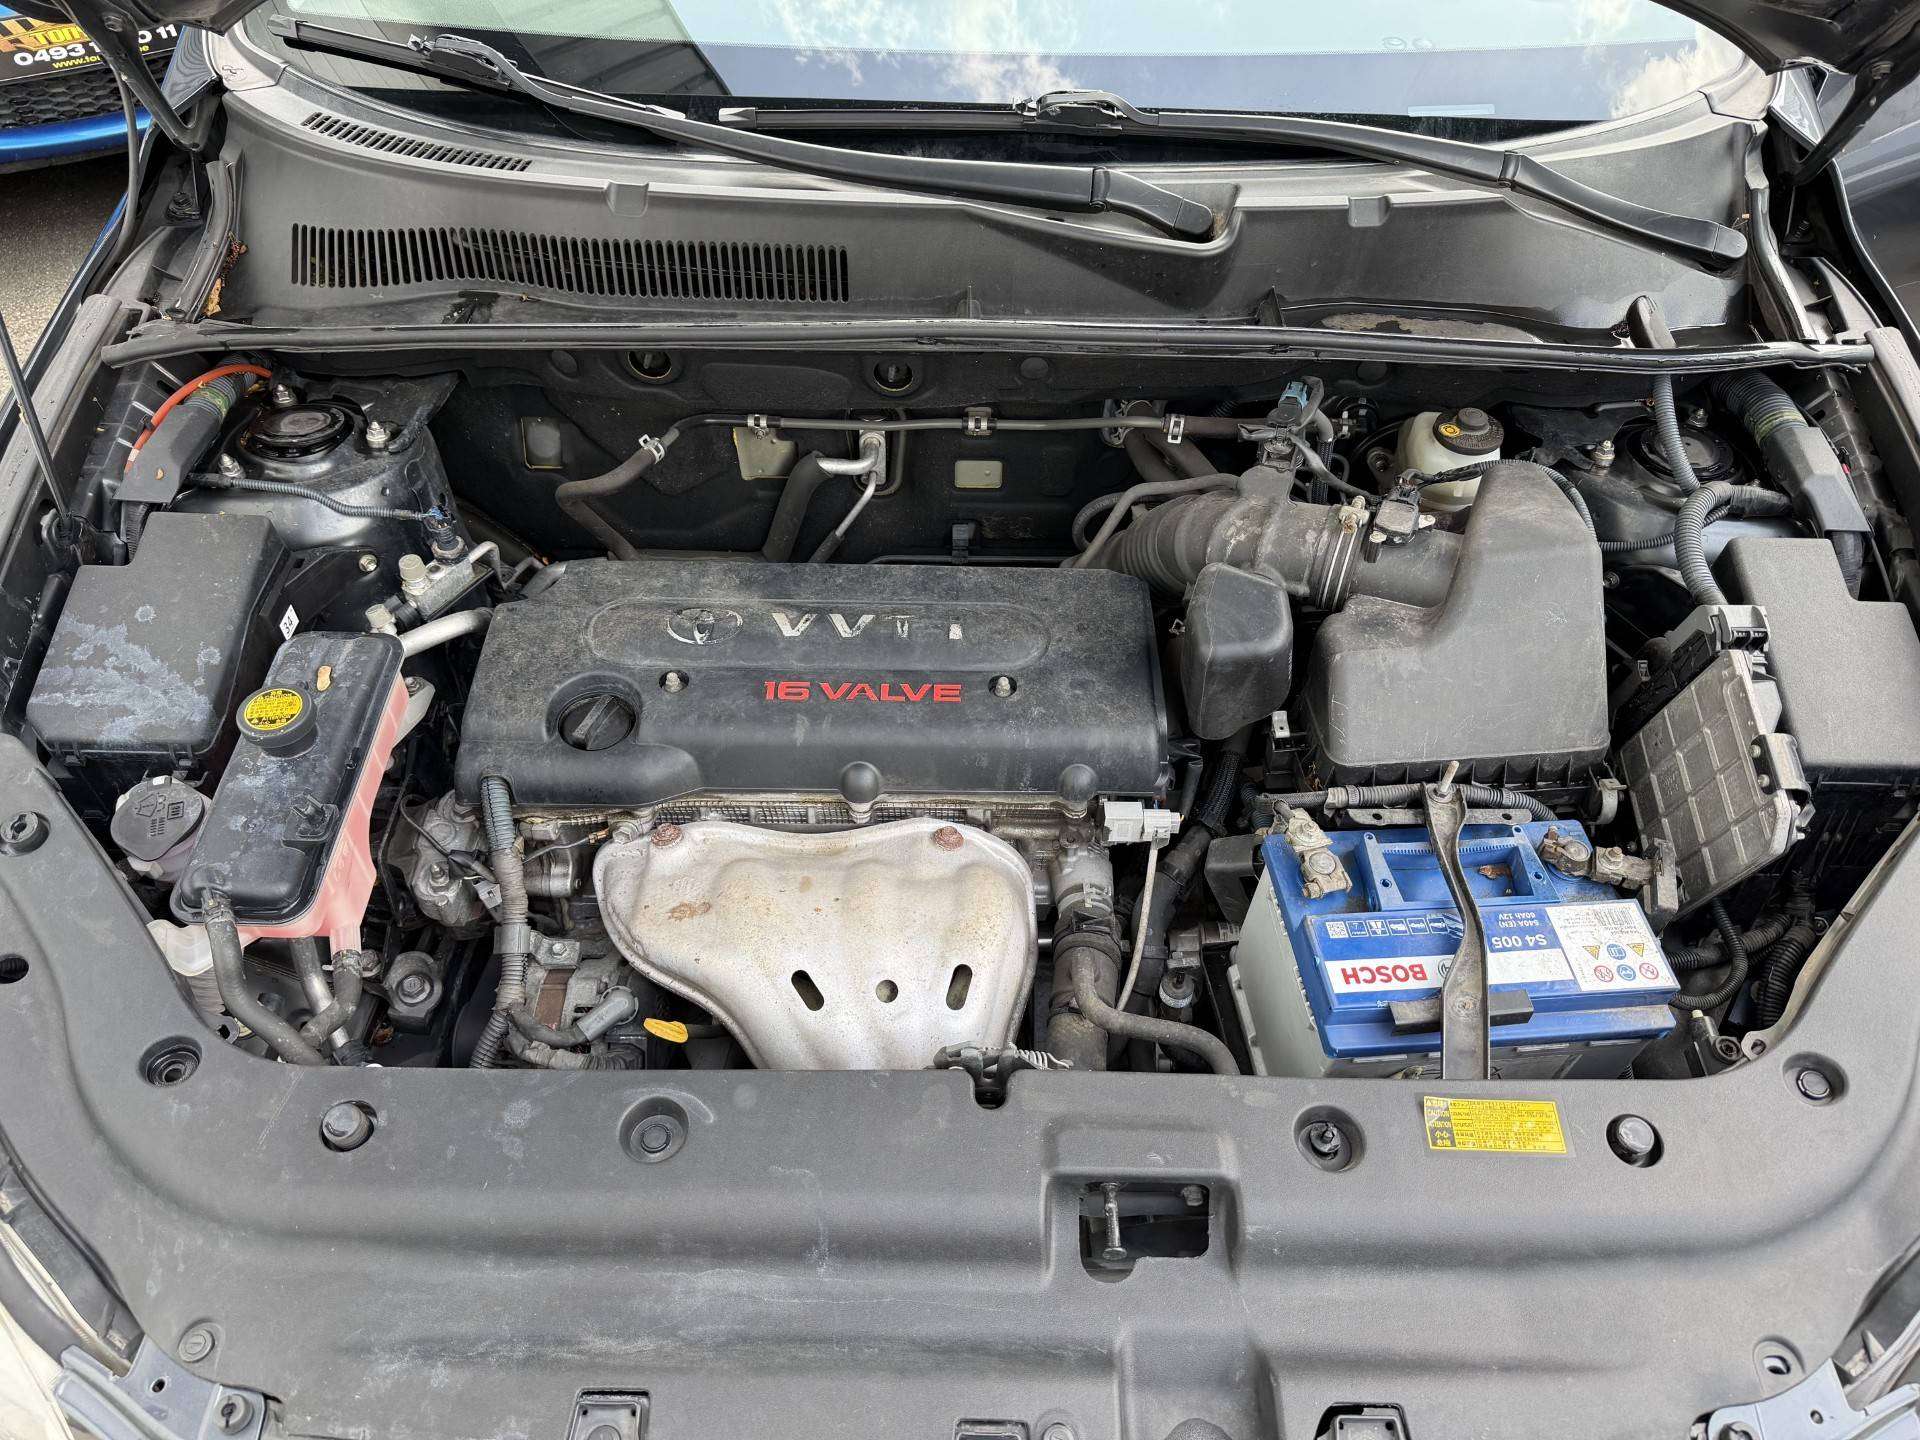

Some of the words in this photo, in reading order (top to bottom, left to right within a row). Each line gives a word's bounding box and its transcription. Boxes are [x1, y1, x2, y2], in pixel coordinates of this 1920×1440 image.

[13, 43, 86, 66] 0493
[764, 681, 811, 701] 16
[819, 682, 962, 703] VALVE
[1491, 935, 1522, 949] 005
[1525, 933, 1548, 947] S4
[1340, 963, 1428, 985] BOSCH
